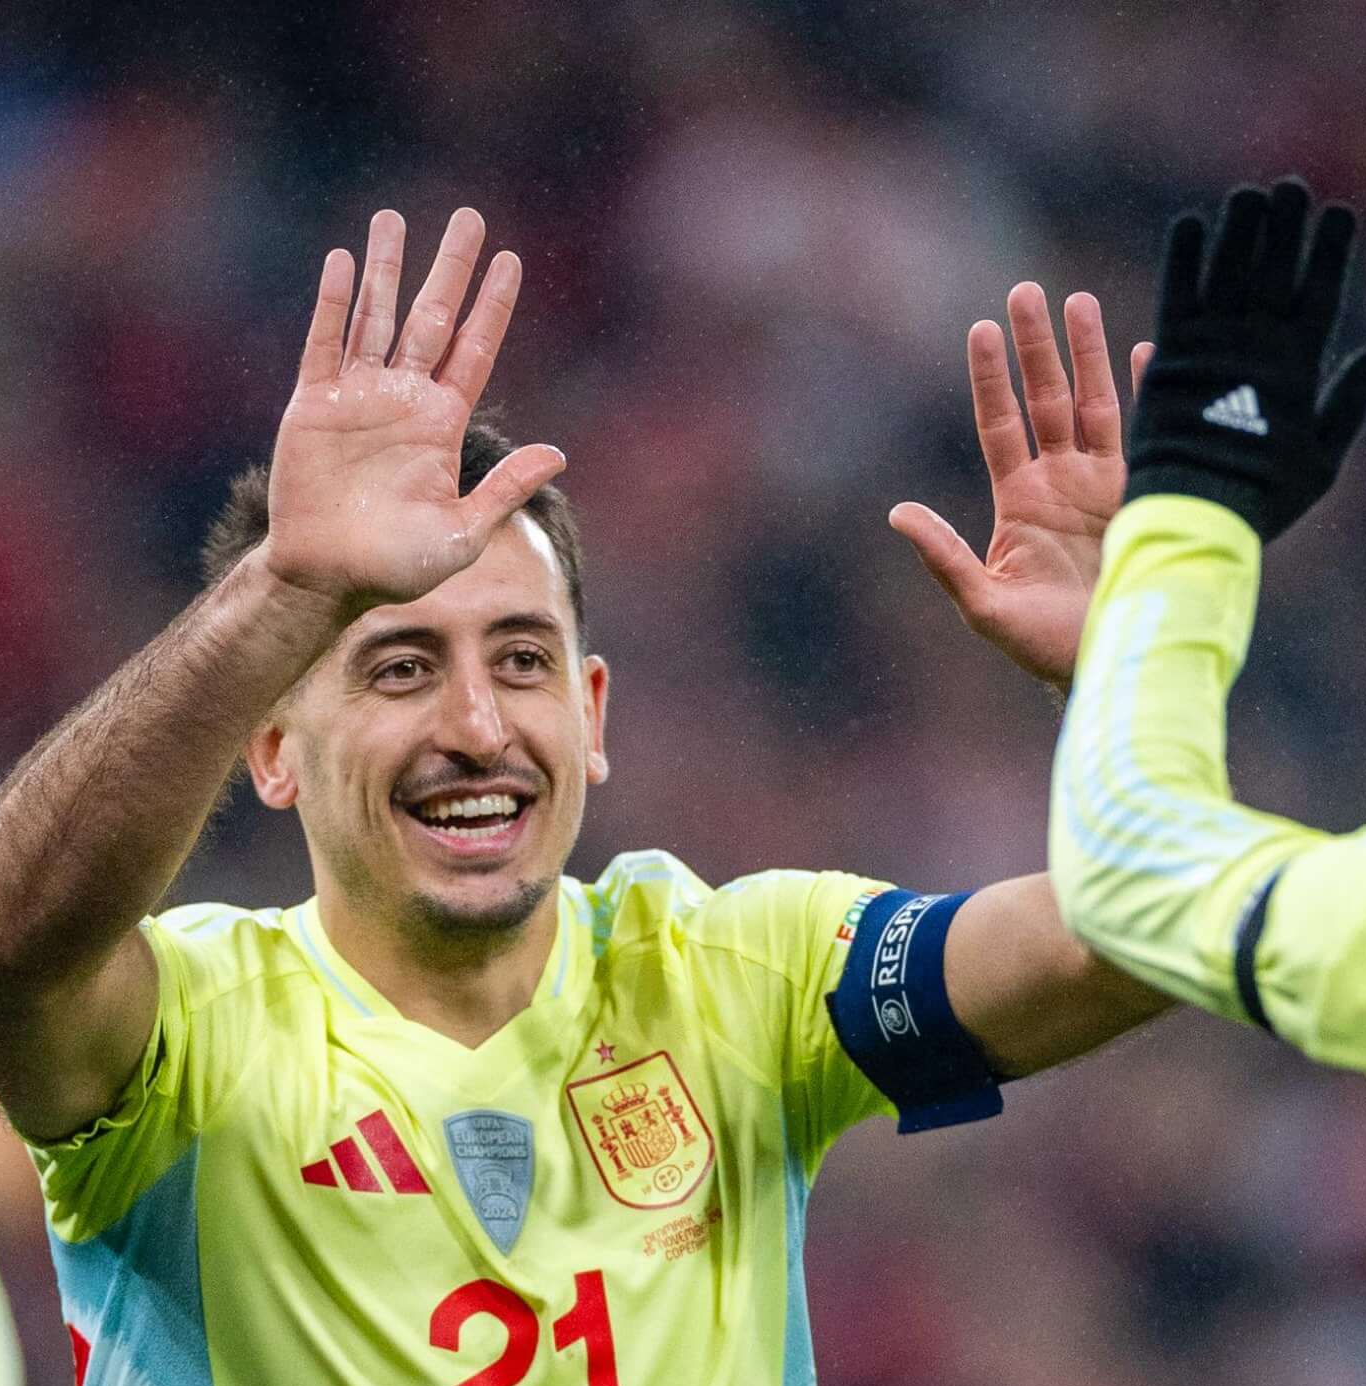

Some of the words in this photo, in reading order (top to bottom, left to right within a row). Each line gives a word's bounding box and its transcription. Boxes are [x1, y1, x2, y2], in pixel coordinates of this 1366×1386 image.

[877, 894, 933, 986] RESPE
[453, 1130, 525, 1145] EUROPEAN
[455, 1144, 527, 1159] CHAMPIONS
[481, 1206, 518, 1220] 2024
